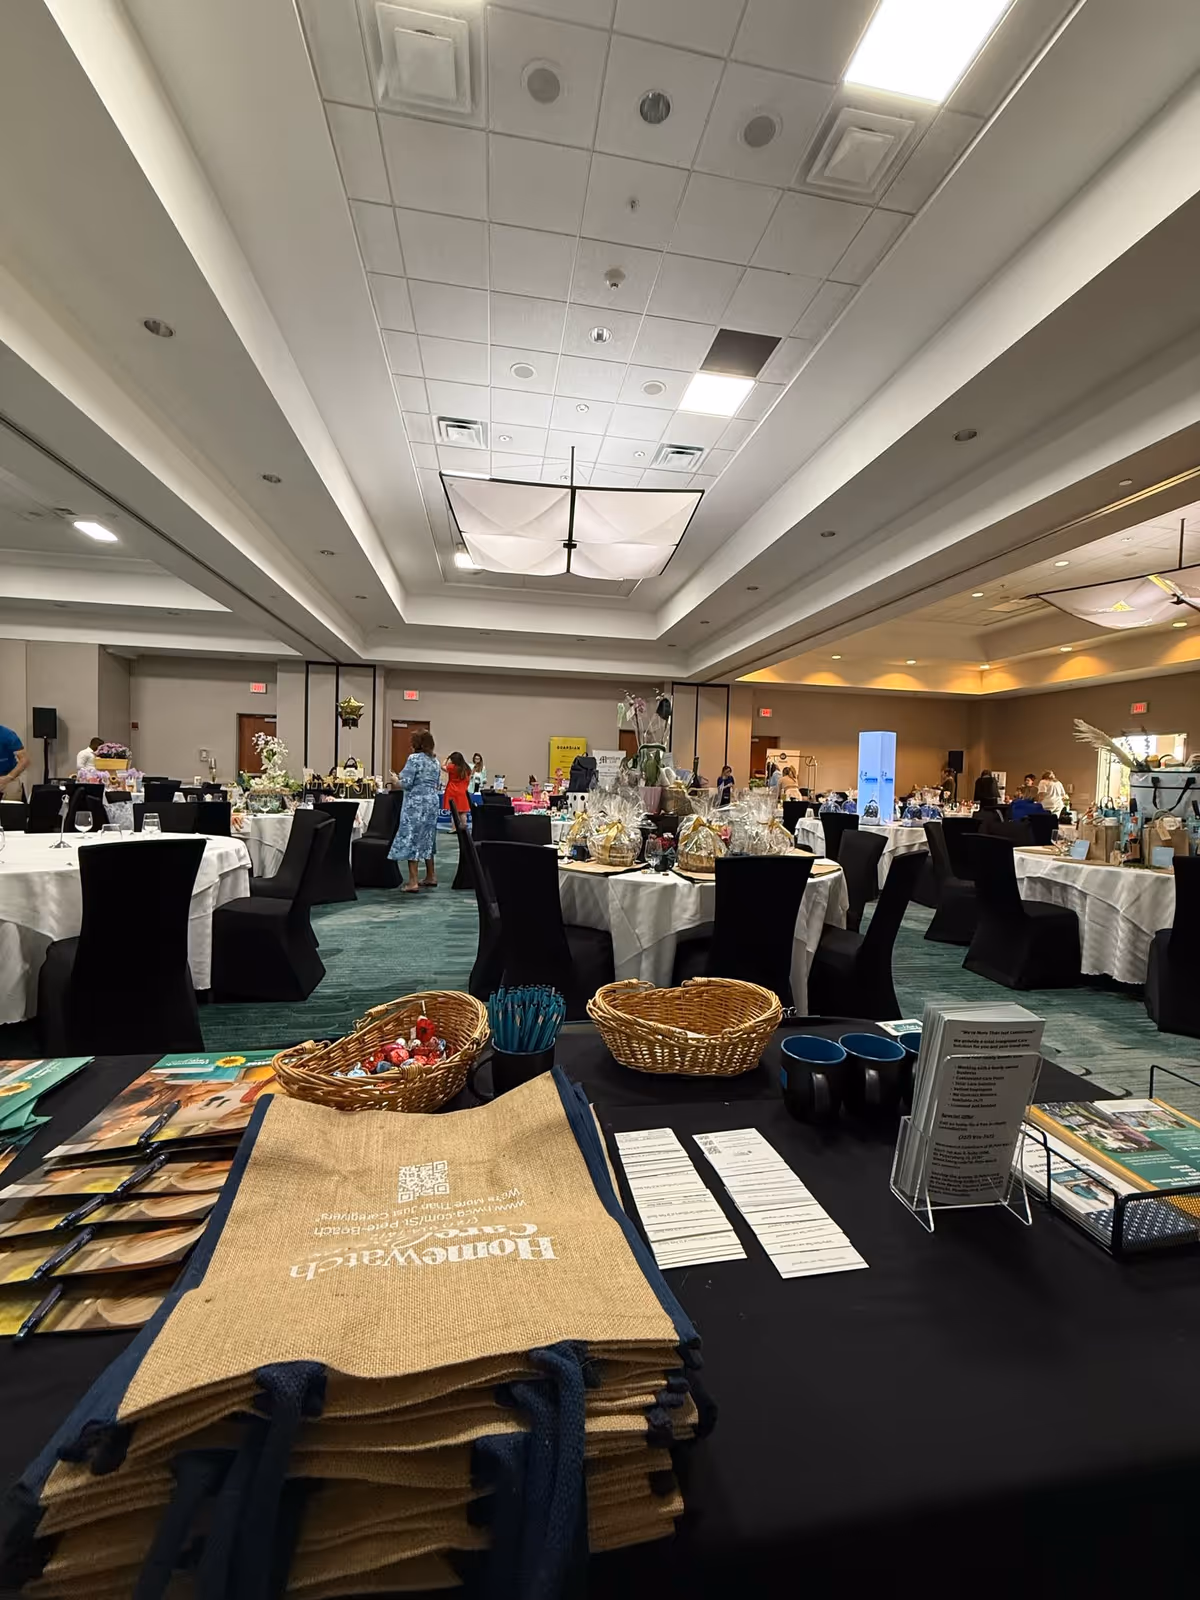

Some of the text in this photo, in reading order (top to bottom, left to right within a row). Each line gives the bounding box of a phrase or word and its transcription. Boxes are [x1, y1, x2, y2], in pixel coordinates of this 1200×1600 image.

[421, 1200, 452, 1214] Than
[454, 1196, 484, 1208] More
[390, 1204, 420, 1218] Just
[290, 1236, 559, 1281] Homewatch
